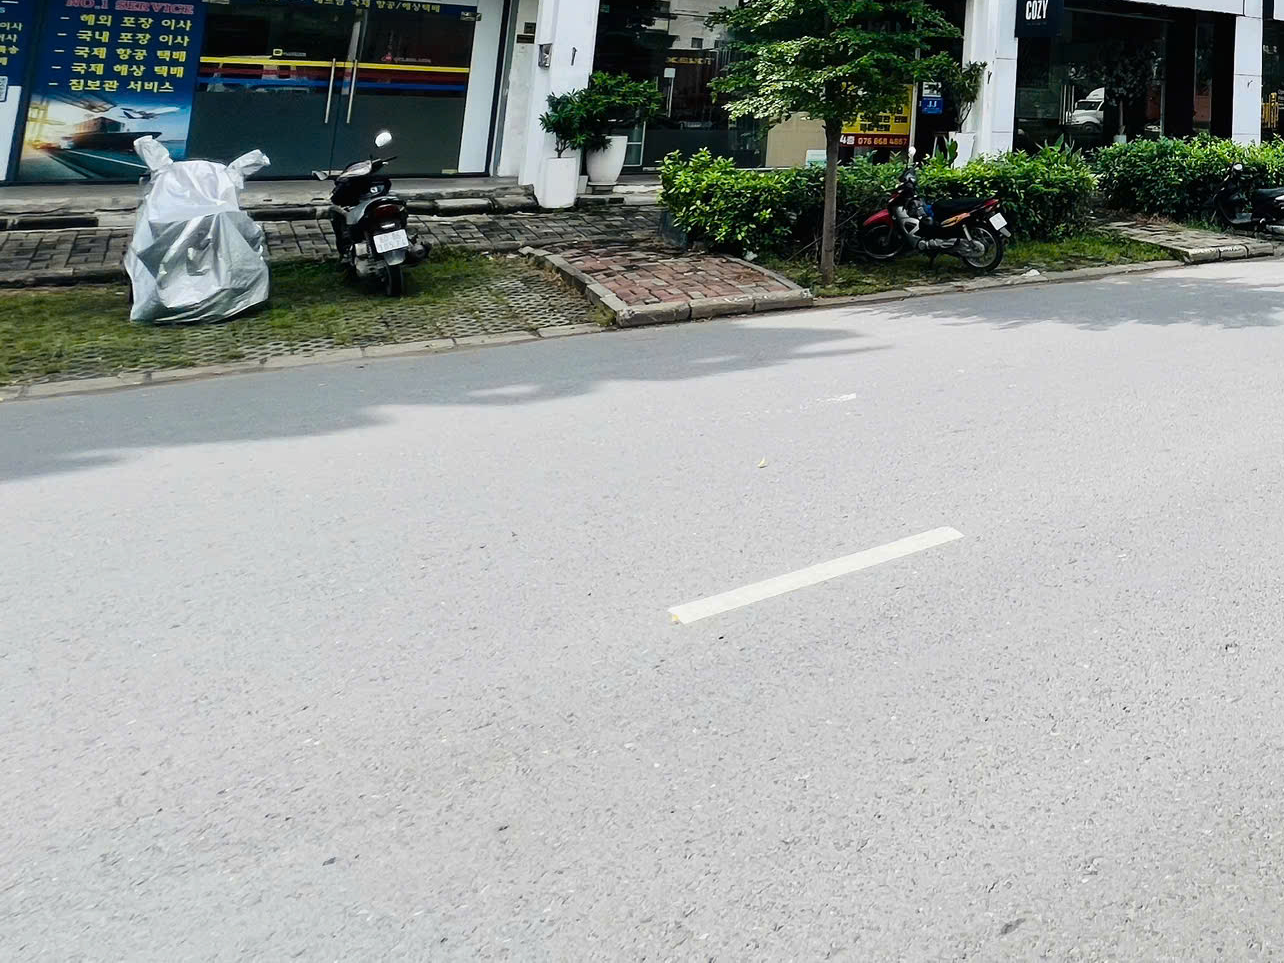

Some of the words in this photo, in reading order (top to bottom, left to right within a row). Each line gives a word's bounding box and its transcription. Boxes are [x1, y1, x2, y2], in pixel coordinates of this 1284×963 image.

[115, 0, 194, 15] SERVICE
[1025, 0, 1049, 20] COZY
[80, 13, 113, 27] 해외
[120, 16, 154, 28] 포장
[161, 18, 192, 31] 이사
[76, 30, 110, 43] 국내
[117, 32, 152, 45] 포장
[159, 34, 190, 47] 이사
[74, 46, 107, 59] 국제
[116, 47, 148, 60] 항공
[156, 49, 187, 62] 택배
[71, 62, 104, 75] 국제
[113, 64, 146, 76] 해상
[154, 65, 184, 78] 택배
[68, 78, 119, 92] 짐보관
[127, 80, 174, 93] 서비스
